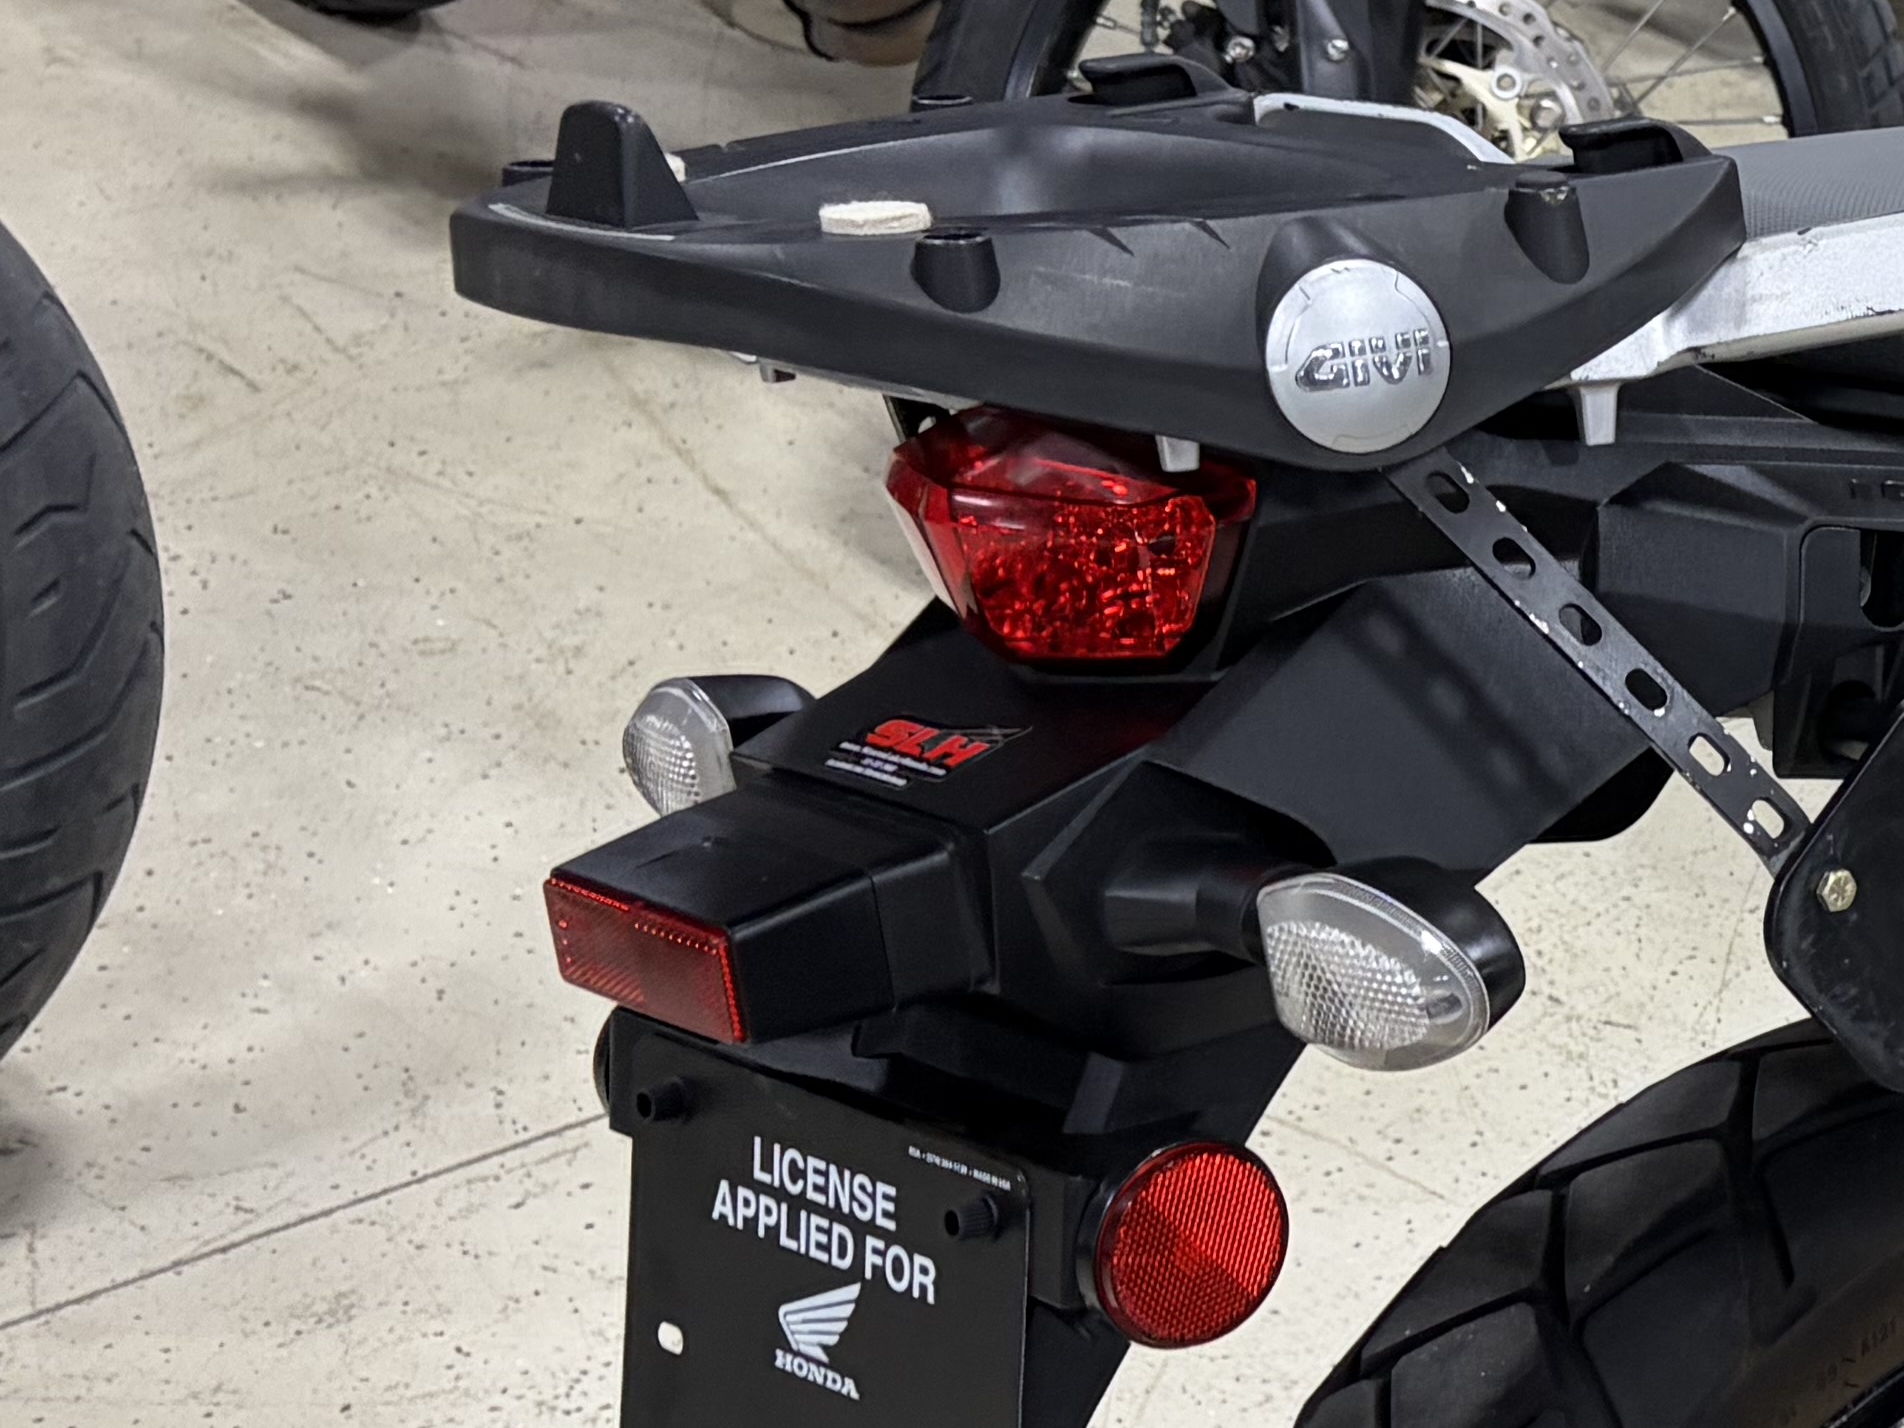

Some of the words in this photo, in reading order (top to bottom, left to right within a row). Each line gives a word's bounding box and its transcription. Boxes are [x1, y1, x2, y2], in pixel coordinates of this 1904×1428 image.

[1295, 327, 1431, 393] GIVI
[865, 718, 991, 769] SLH
[752, 1135, 897, 1232] LICENSE
[711, 1178, 855, 1271] APPLIED
[863, 1234, 937, 1304] FOR
[774, 1348, 860, 1401] HONDA
